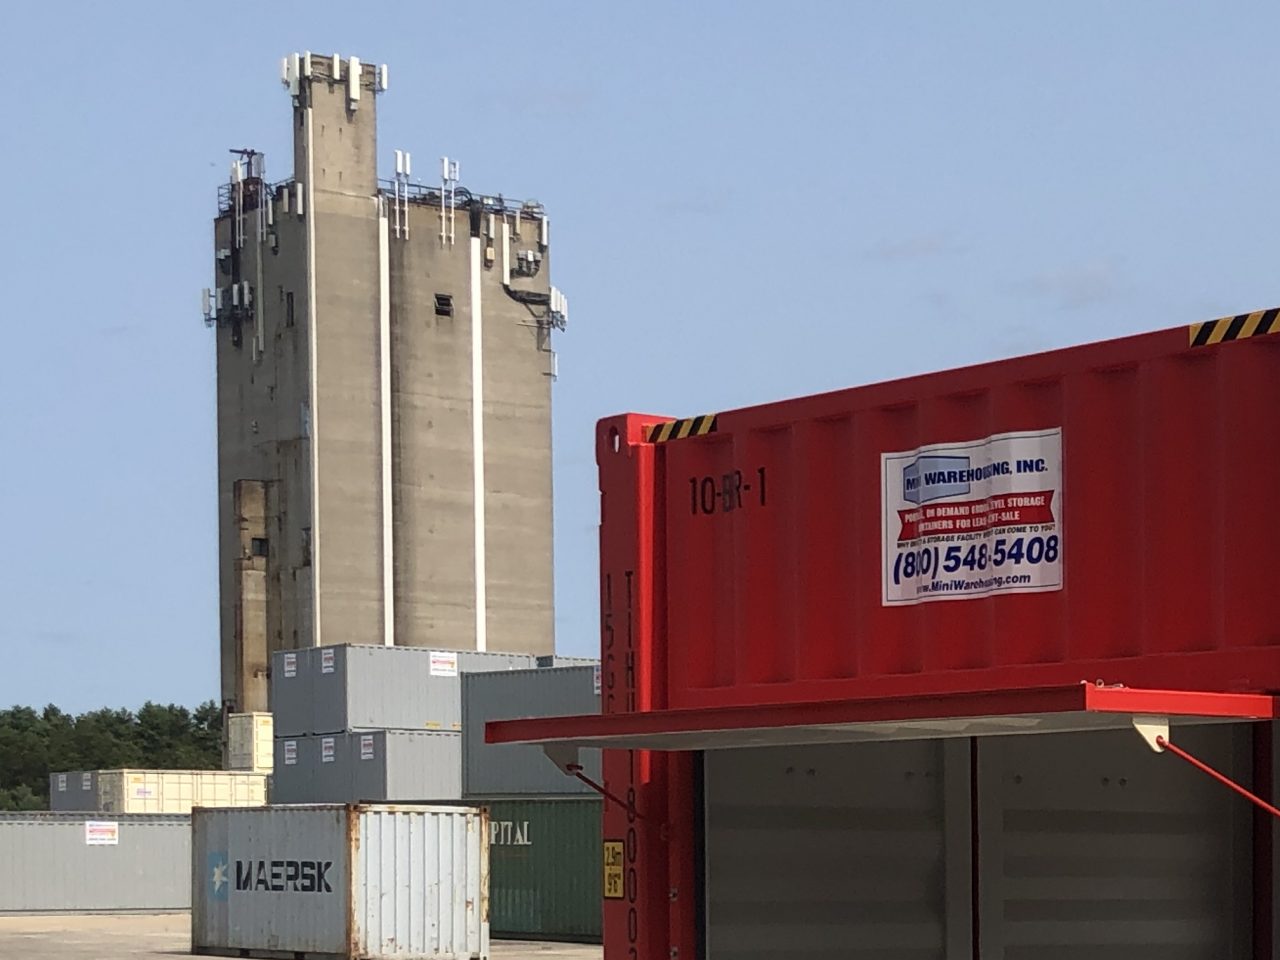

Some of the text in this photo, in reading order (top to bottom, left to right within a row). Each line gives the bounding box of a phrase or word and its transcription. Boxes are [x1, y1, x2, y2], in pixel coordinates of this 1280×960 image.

[1016, 457, 1048, 473] INC.
[936, 506, 970, 517] DEMAND
[1007, 495, 1046, 508] STORAGE
[956, 518, 971, 529] FOR
[1007, 525, 1027, 534] COME
[1029, 525, 1039, 533] TO
[236, 859, 333, 893] MAERSK
